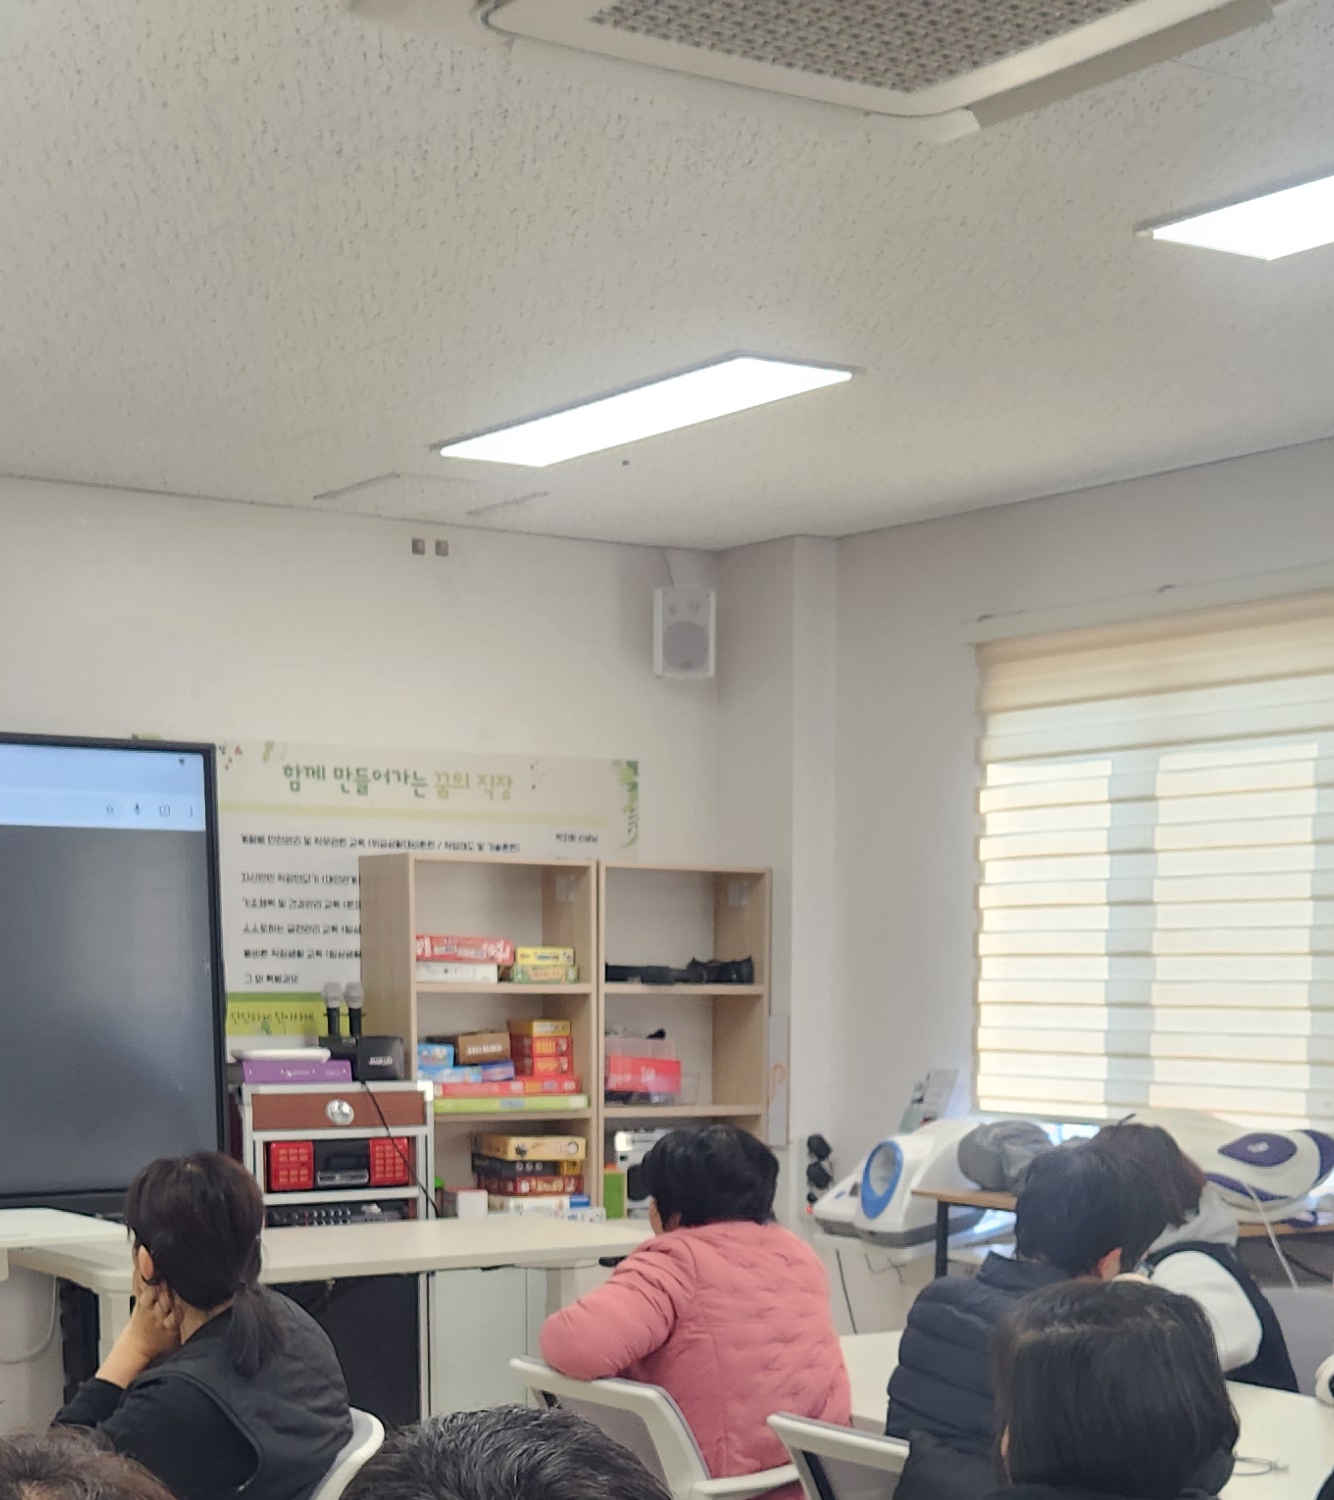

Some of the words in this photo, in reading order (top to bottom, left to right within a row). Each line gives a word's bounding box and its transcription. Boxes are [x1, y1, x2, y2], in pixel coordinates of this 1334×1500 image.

[283, 763, 326, 792] 함께
[333, 766, 428, 798] 만들어가는
[434, 771, 470, 799] 꿈의
[477, 774, 513, 800] 직장
